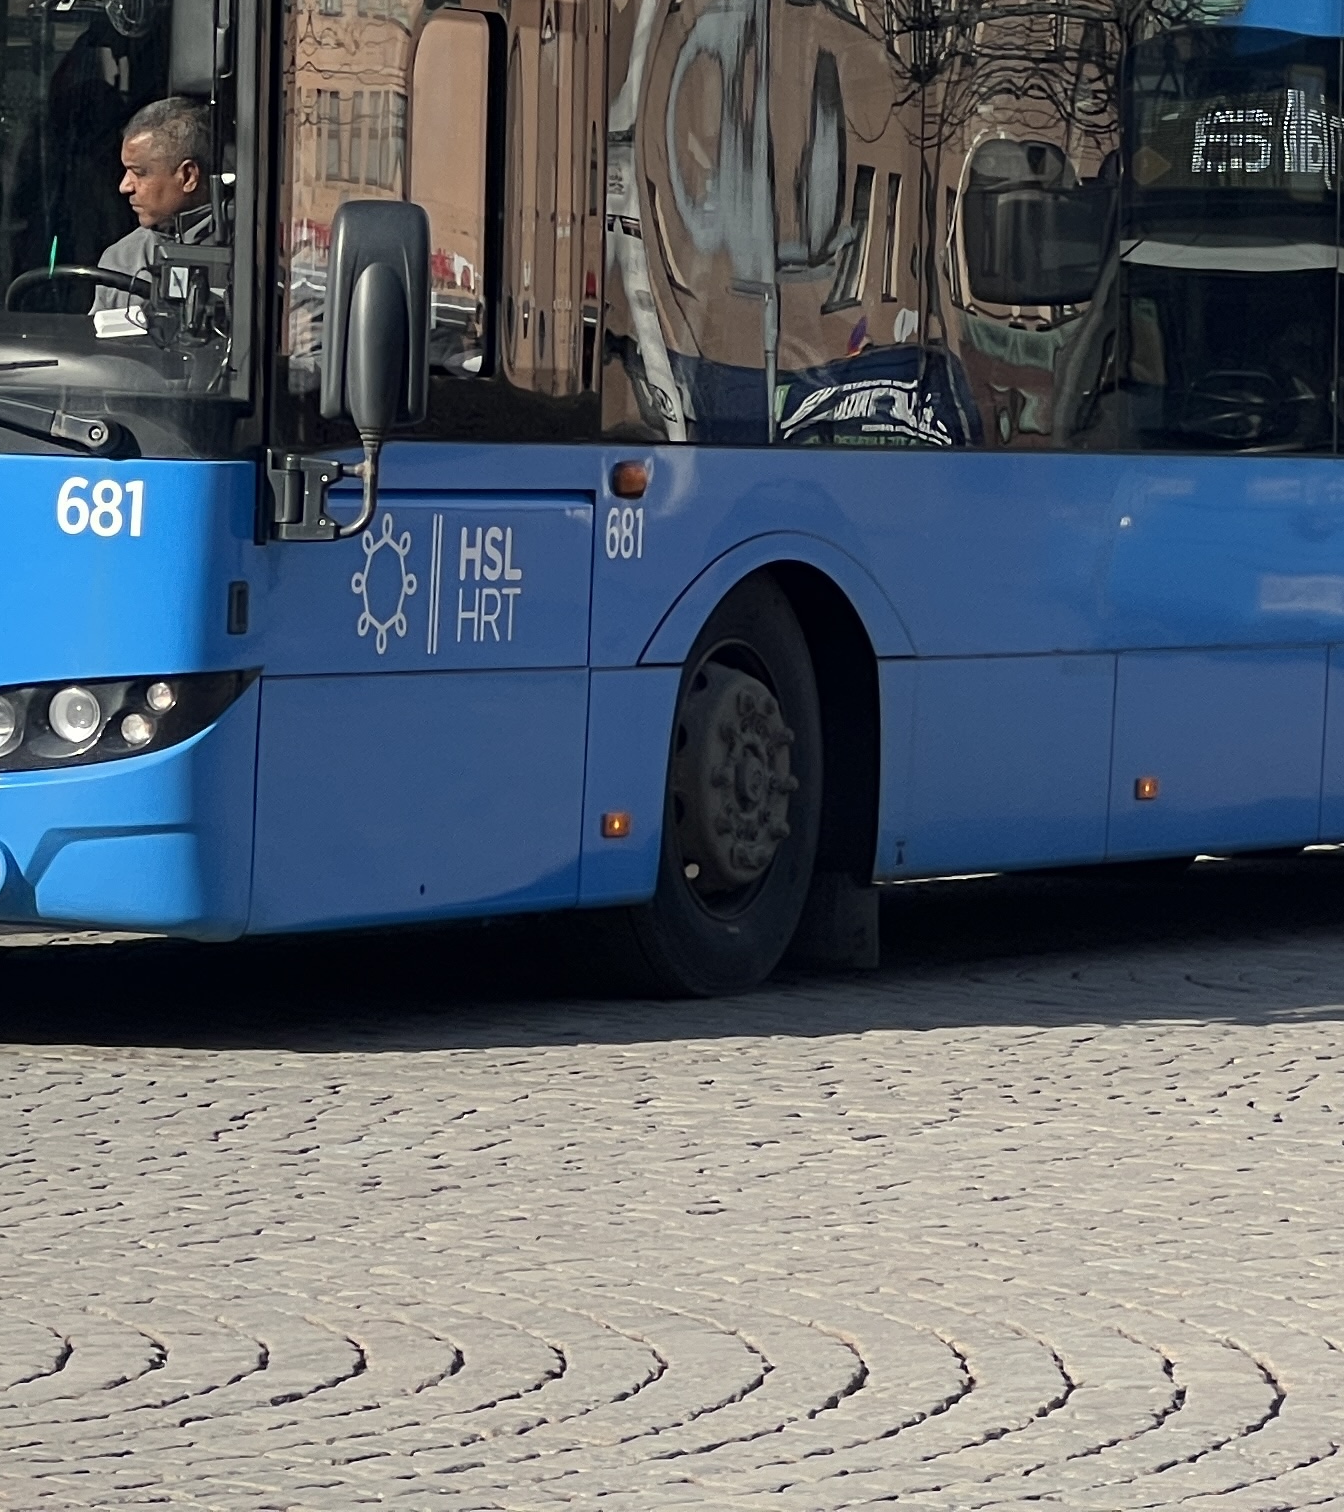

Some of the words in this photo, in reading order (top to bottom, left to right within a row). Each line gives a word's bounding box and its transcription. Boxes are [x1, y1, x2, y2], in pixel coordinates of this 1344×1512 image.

[56, 476, 145, 538] 681
[604, 507, 644, 560] 681
[460, 526, 523, 582] HSL
[457, 587, 523, 642] HRT
